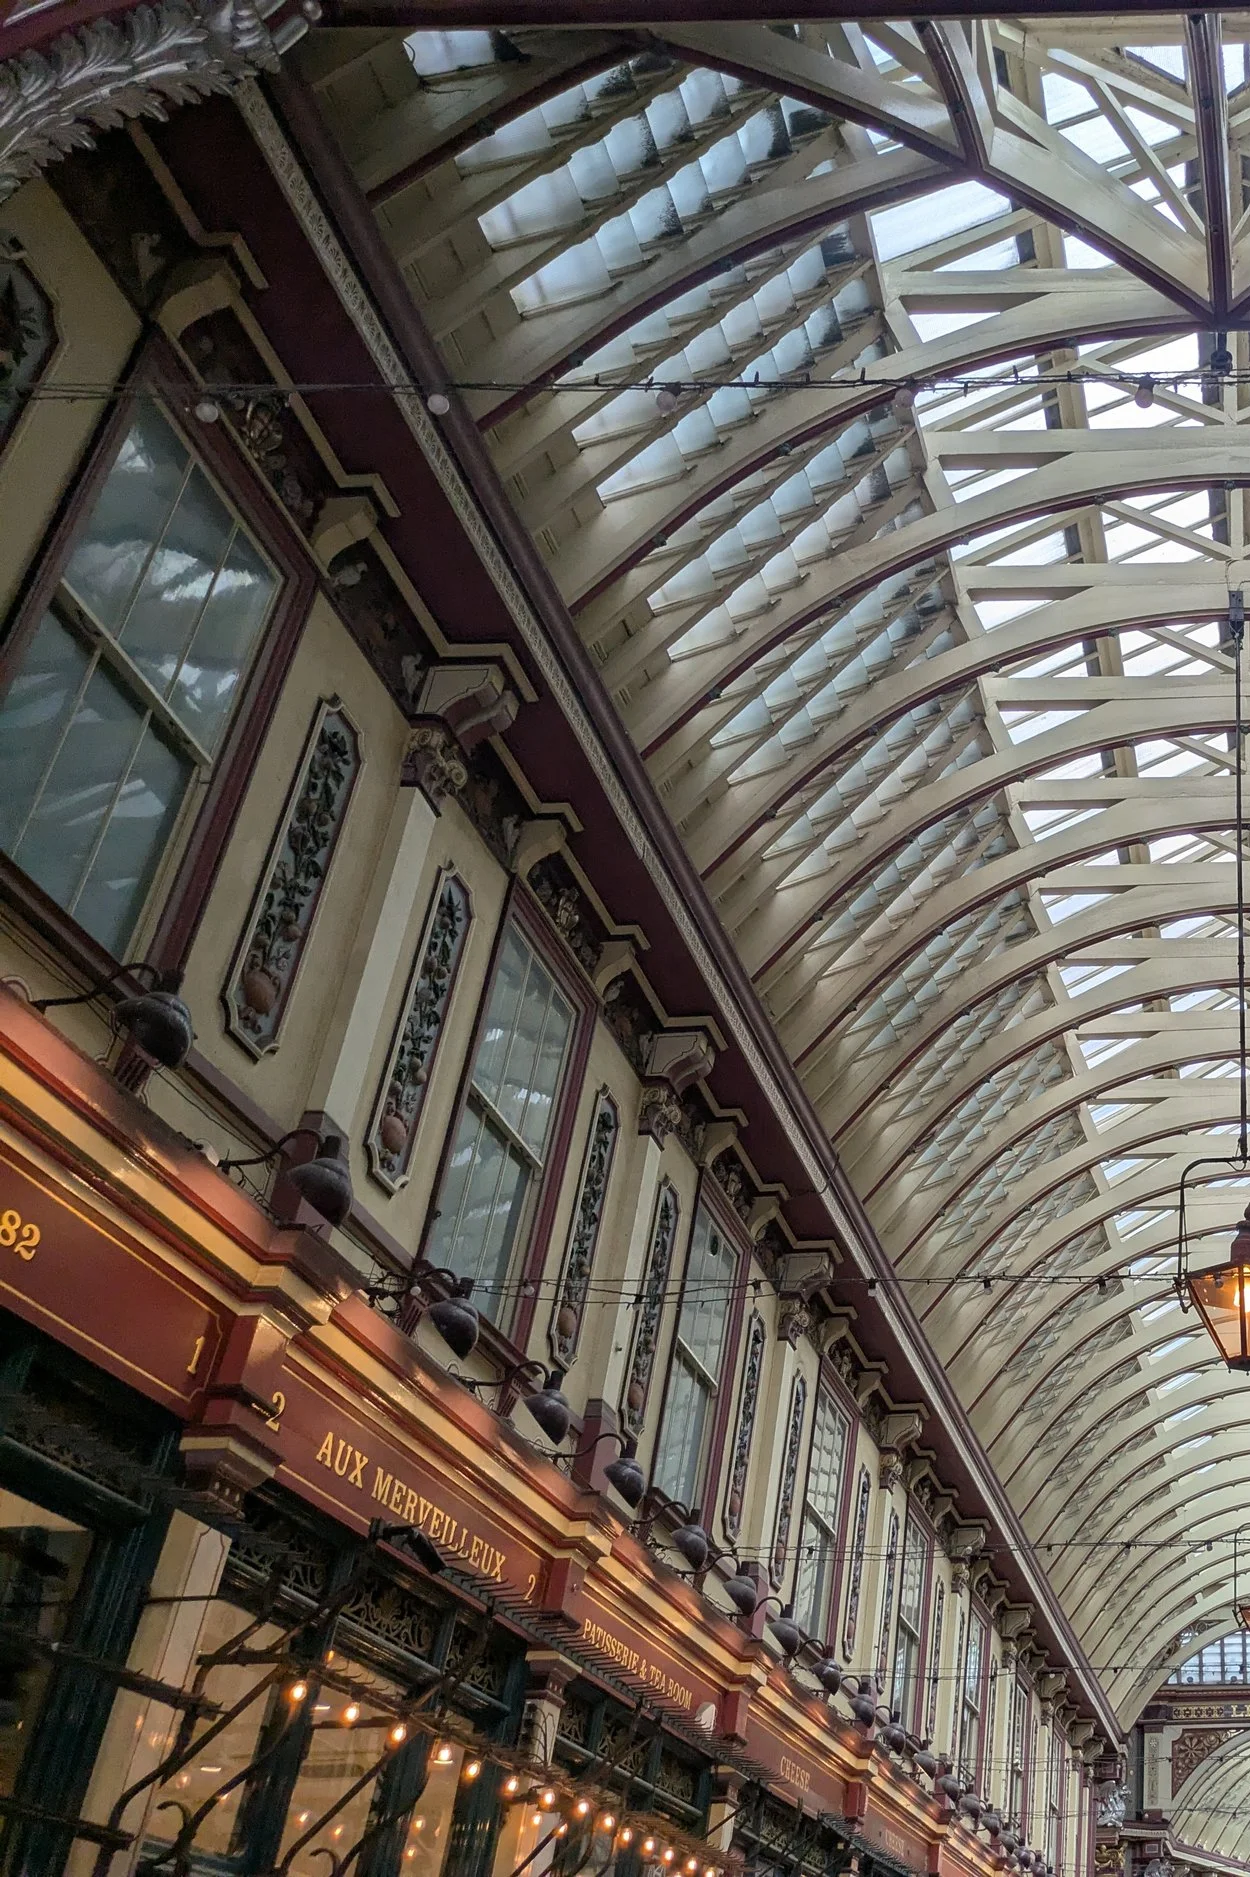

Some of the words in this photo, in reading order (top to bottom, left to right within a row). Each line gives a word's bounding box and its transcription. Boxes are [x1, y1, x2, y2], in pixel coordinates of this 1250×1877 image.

[186, 1336, 205, 1374] 1
[265, 1391, 286, 1432] 2
[315, 1431, 370, 1490] AUX
[370, 1466, 506, 1583] MERVEILLEUX
[583, 1618, 640, 1674] PATISSERIE
[639, 1659, 648, 1681] &
[648, 1664, 667, 1694] TEA
[666, 1678, 693, 1710] ROOM
[780, 1755, 811, 1793] CHEESE
